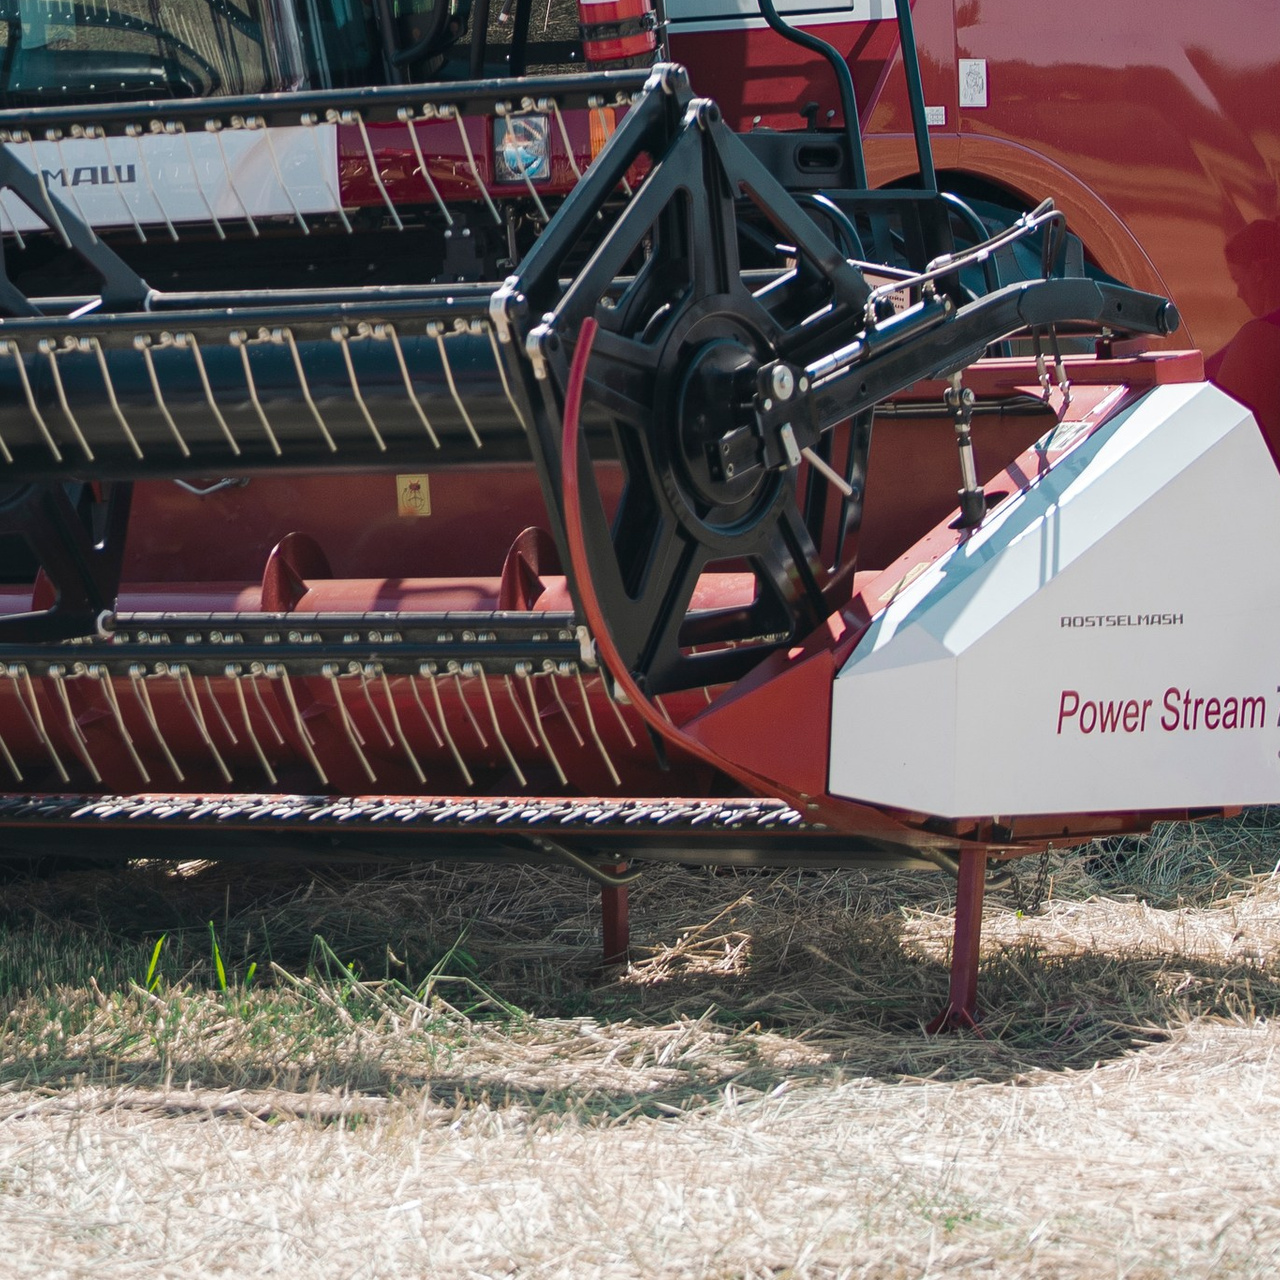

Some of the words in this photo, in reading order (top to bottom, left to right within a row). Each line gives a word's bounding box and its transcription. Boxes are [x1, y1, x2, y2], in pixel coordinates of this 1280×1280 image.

[1060, 613, 1184, 628] ROSTSELMASH
[1056, 689, 1153, 735] Power
[1160, 686, 1267, 732] Stream
